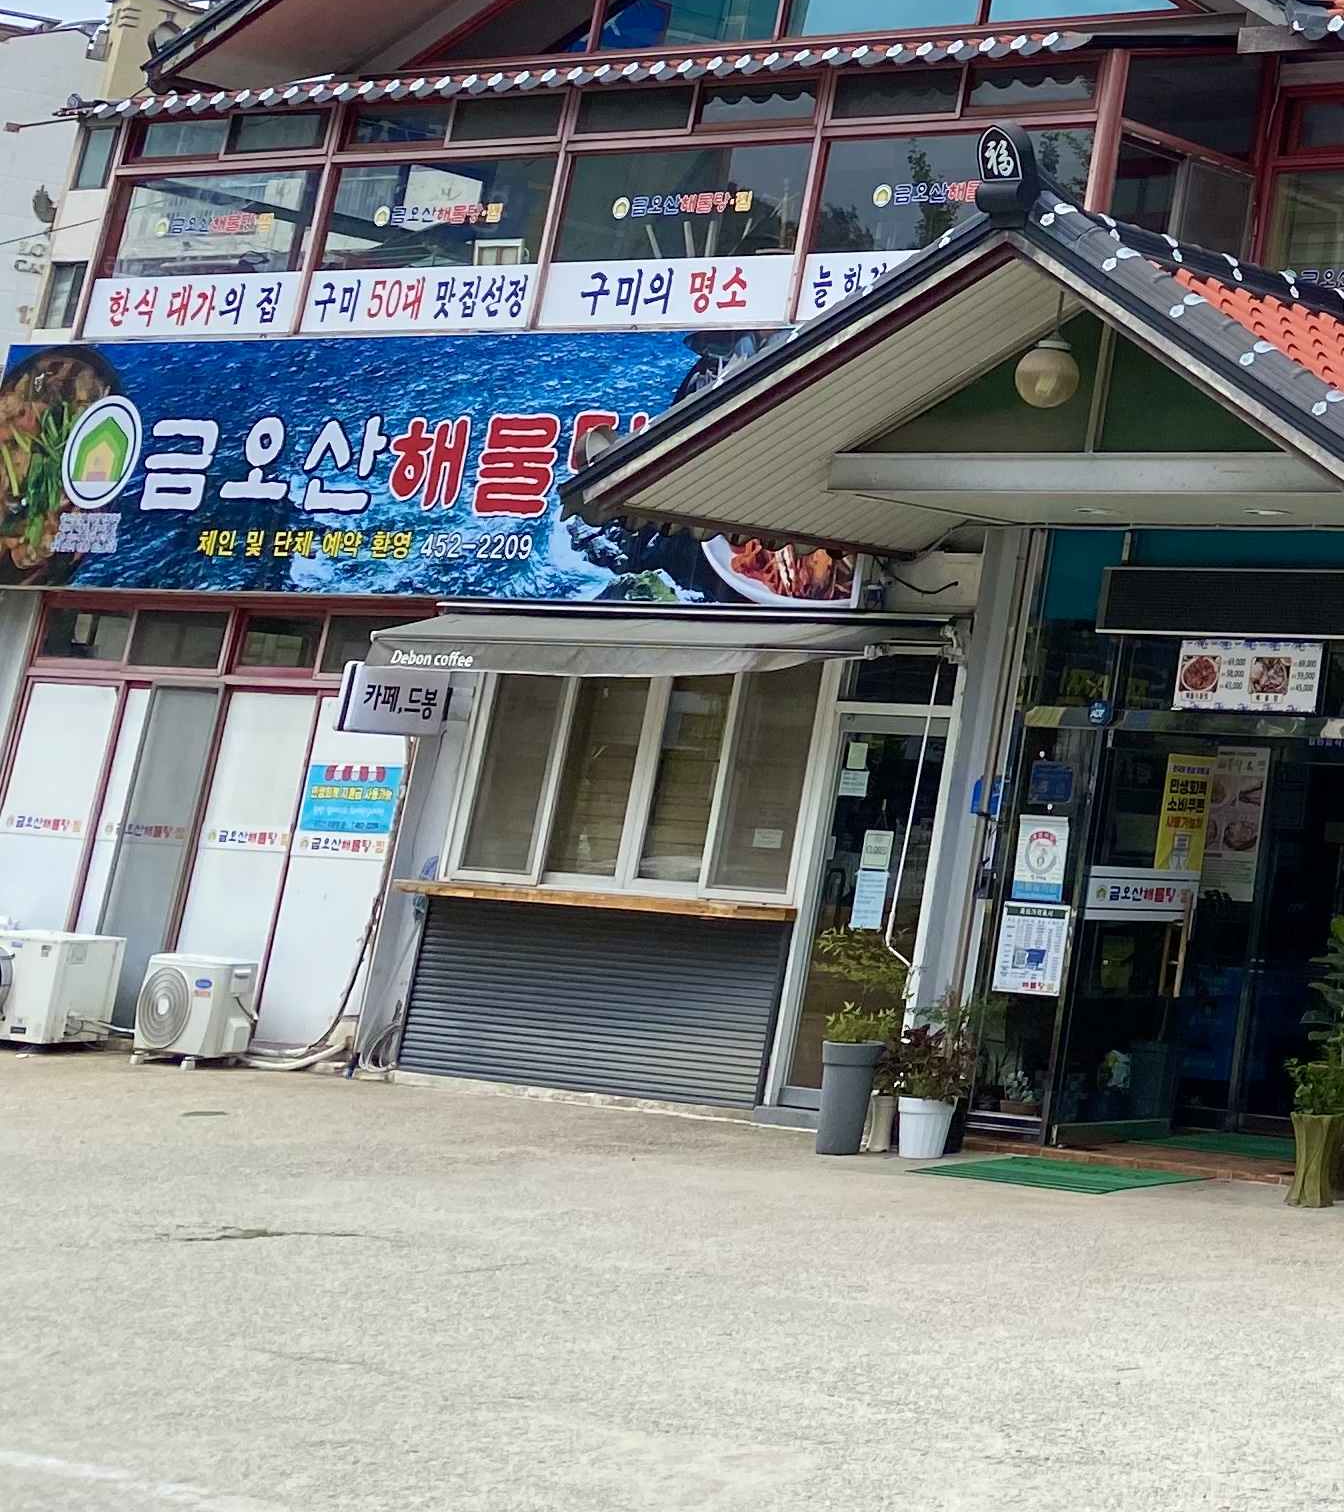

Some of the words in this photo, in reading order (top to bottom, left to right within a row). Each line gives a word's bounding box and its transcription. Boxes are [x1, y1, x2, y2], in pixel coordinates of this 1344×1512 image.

[985, 139, 1014, 177] 福
[108, 286, 159, 328] 한식
[166, 282, 247, 327] 대가의
[255, 281, 283, 324] 집
[313, 279, 361, 323] 구미
[366, 276, 425, 322] 50대
[433, 273, 529, 320] 맛집선정
[580, 267, 674, 316] 구미의
[689, 266, 747, 314] 명소
[813, 265, 832, 309] 늘
[140, 410, 650, 519] 금오산해물
[197, 530, 236, 556] 체인
[246, 530, 264, 557] 및
[273, 530, 314, 557] 단체
[321, 531, 361, 558] 예약
[370, 531, 413, 559] 환영
[420, 532, 532, 560] 452-2209
[390, 650, 431, 665] Debon
[434, 651, 473, 667] coffee
